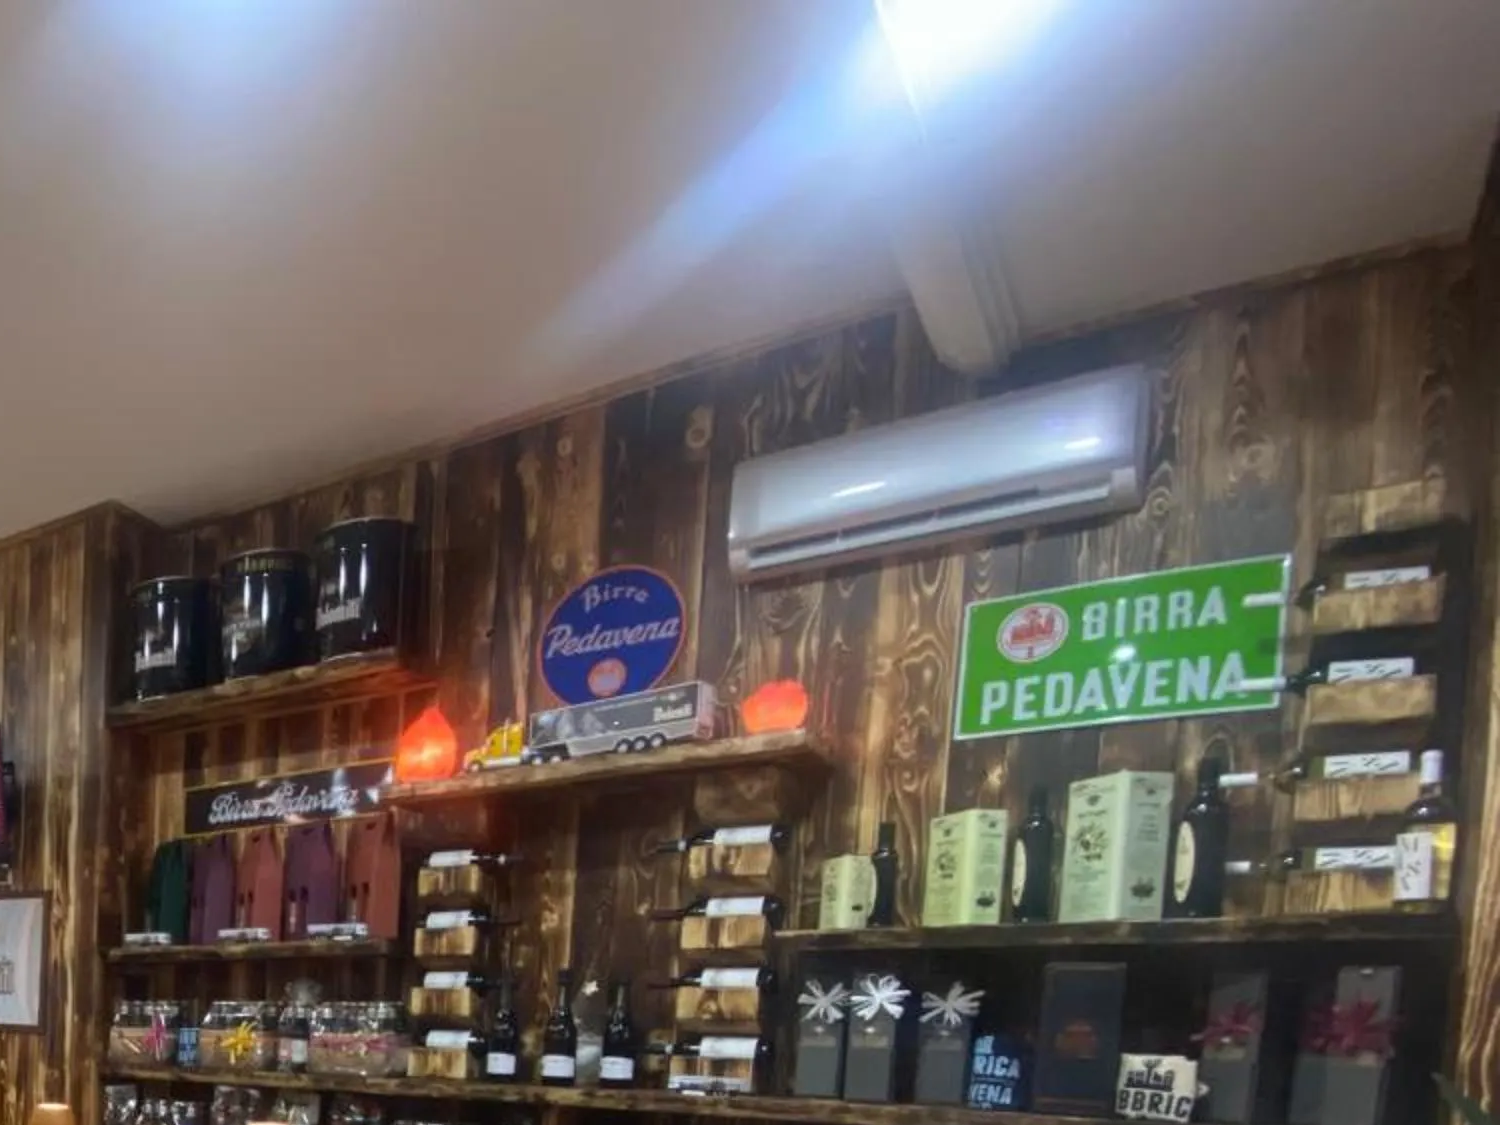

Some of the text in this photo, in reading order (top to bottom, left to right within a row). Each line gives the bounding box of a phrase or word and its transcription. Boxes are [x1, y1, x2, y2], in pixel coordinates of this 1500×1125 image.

[547, 616, 680, 658] Pedavena
[1081, 586, 1227, 641] BIRRA
[980, 650, 1247, 725] PEDAVENA
